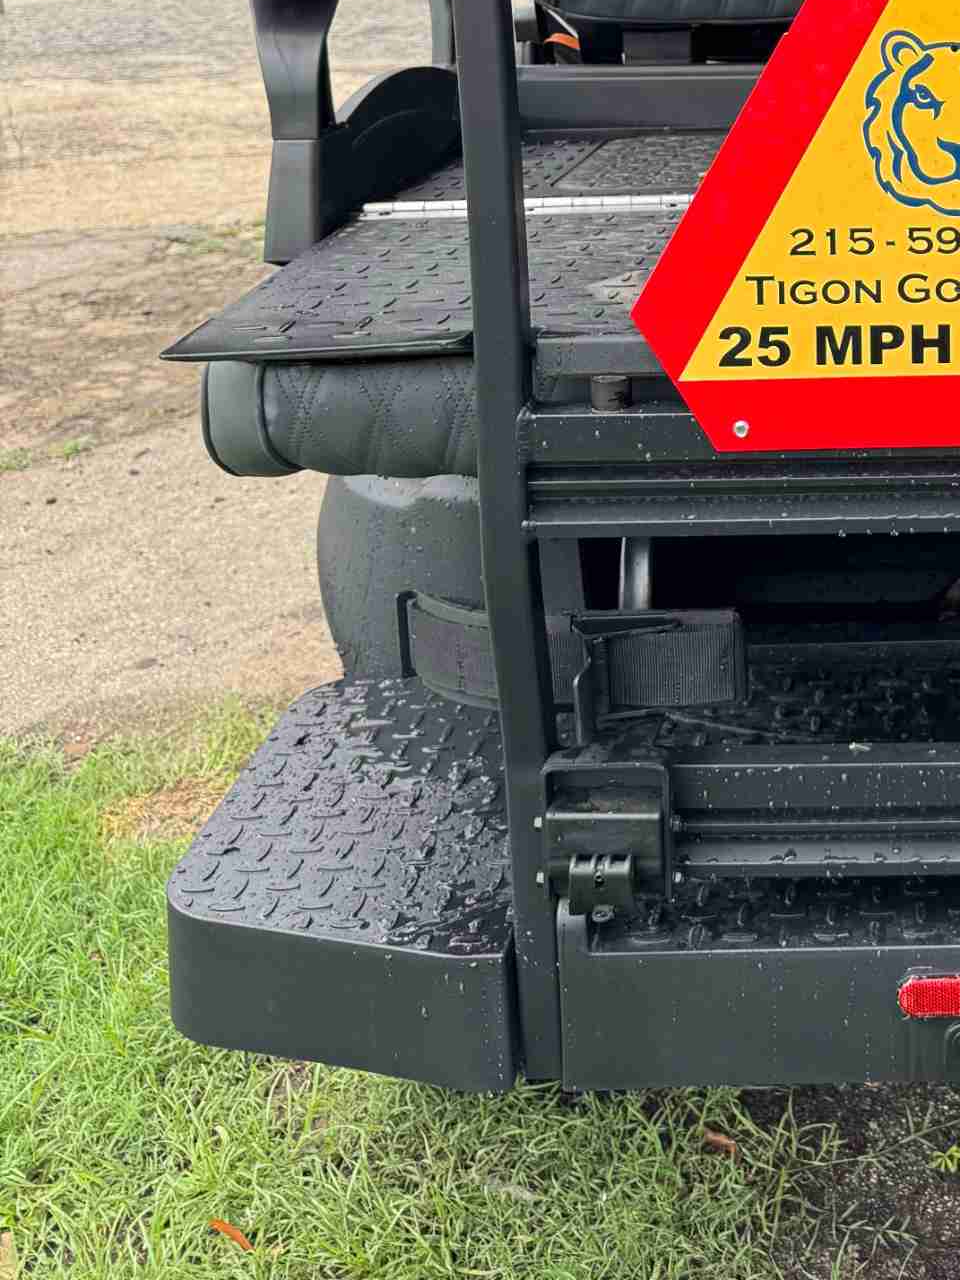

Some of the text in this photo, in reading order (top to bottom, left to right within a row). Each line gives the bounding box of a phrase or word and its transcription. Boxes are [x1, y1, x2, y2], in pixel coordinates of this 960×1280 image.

[746, 275, 882, 305] TIGON
[719, 327, 791, 367] 25
[816, 325, 951, 365] MPH
